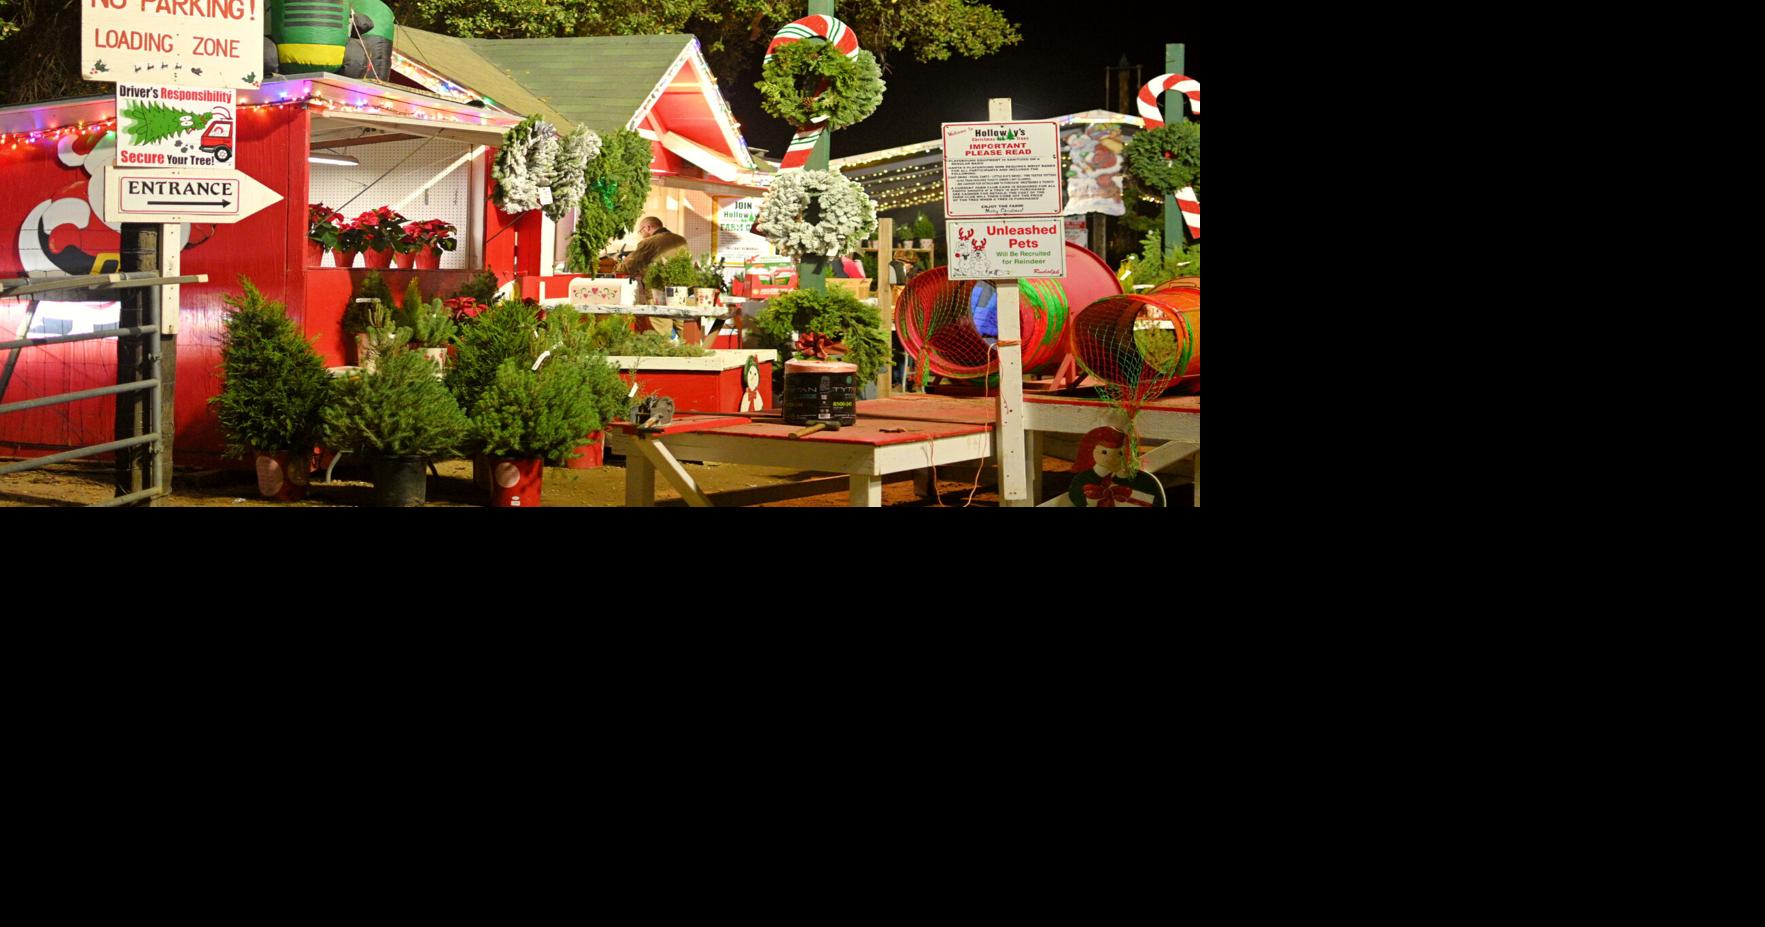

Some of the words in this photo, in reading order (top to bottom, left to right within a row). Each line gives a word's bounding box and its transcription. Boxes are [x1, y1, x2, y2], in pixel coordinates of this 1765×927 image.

[95, 28, 174, 53] LOADING
[192, 36, 241, 58] ZONE
[119, 85, 159, 99] Driver's
[160, 87, 232, 104] Responsibility
[969, 142, 1027, 150] IMPORTANT
[120, 150, 165, 164] Secure
[167, 154, 188, 165] Your
[190, 155, 215, 166] Tree!
[128, 181, 233, 196] ENTRANCE
[734, 201, 752, 210] JOIN
[986, 225, 1057, 236] Unleashed
[1008, 238, 1039, 249] Pets
